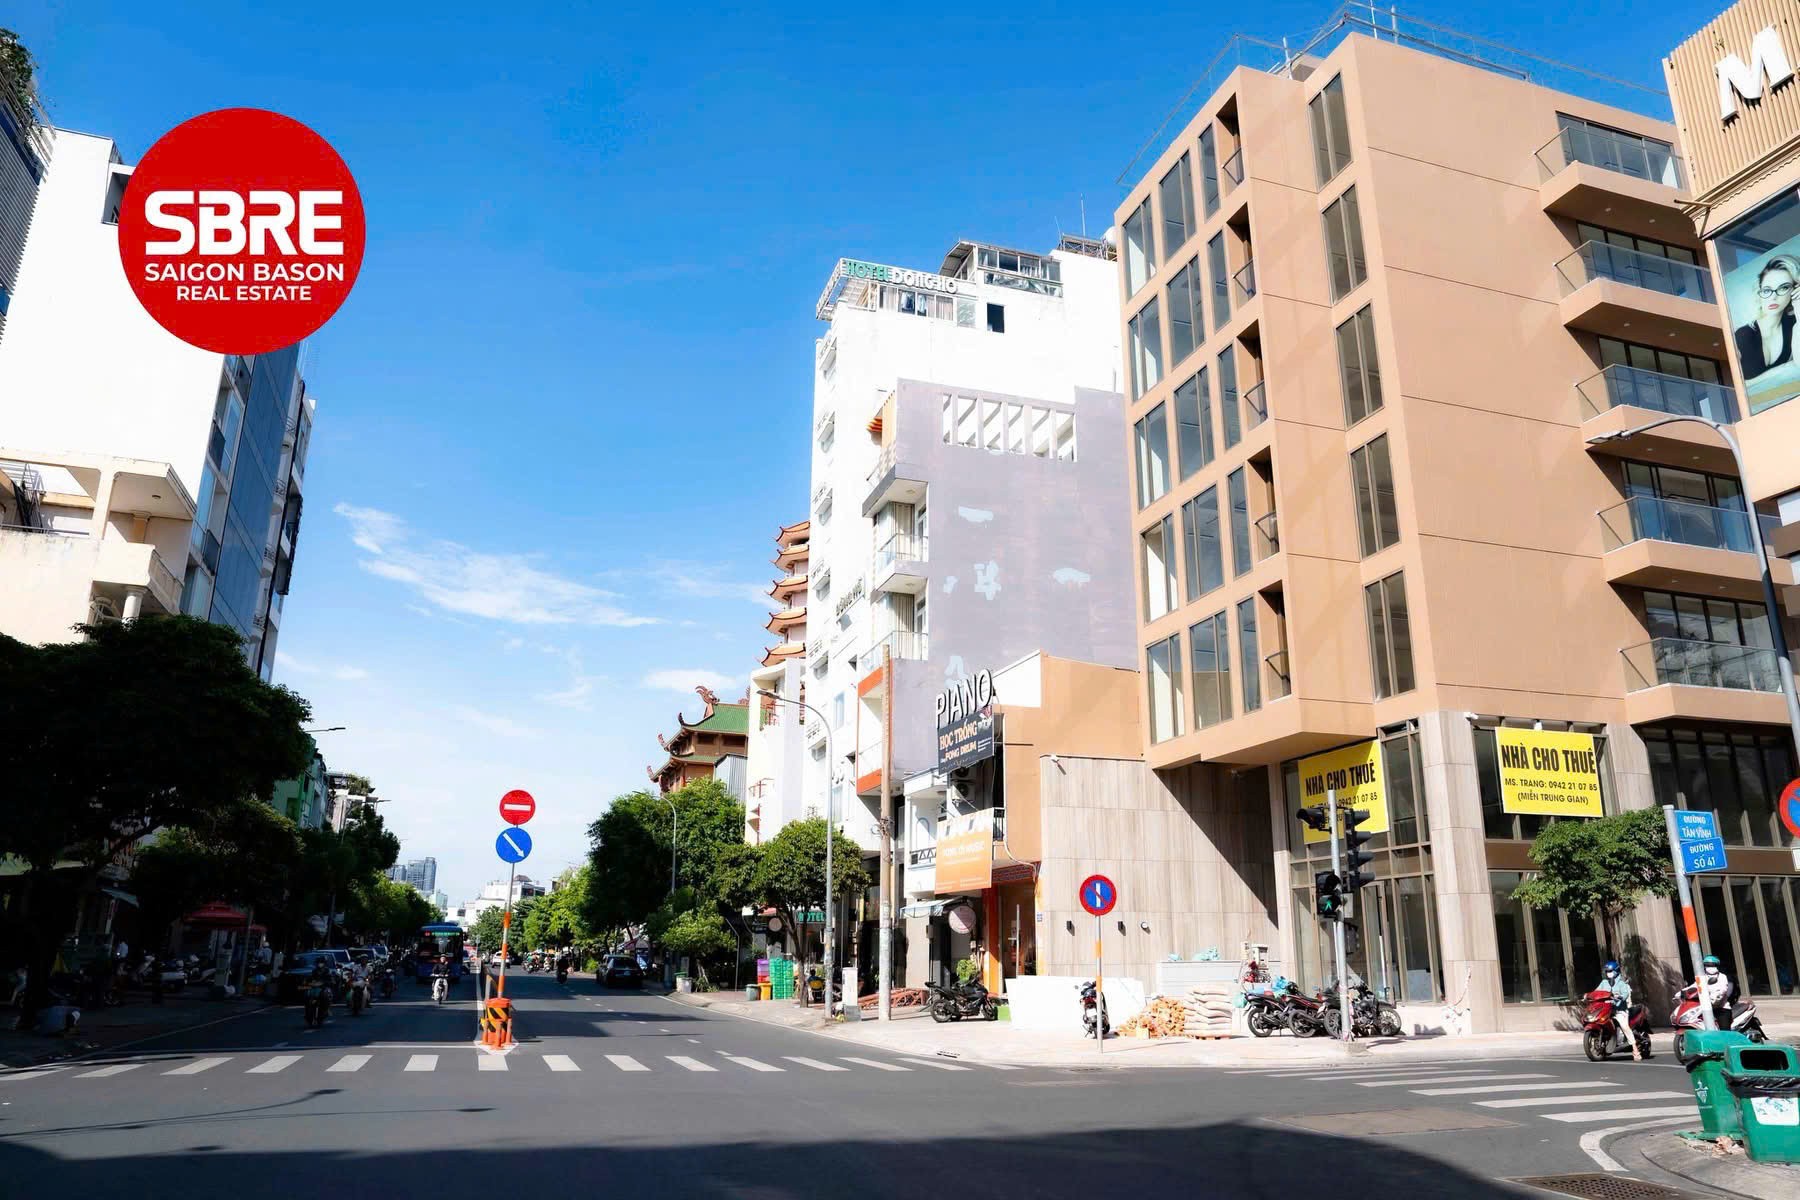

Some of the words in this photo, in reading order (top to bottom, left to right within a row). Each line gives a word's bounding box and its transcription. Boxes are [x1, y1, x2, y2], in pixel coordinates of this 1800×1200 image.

[846, 261, 888, 281] HOTEL
[936, 669, 992, 729] PIANO
[1501, 742, 1529, 769] NHÀ
[1532, 747, 1559, 772] CHO
[1562, 747, 1596, 774] THUÊ
[1305, 772, 1324, 797] NHÀ
[1327, 769, 1347, 791] CHO
[1349, 759, 1375, 786] THUÊ
[1548, 781, 1566, 790] 0942
[1568, 782, 1576, 790] 21
[1578, 783, 1586, 791] 07
[1541, 793, 1565, 803] TRUNG
[1694, 854, 1706, 868] SỐ
[1707, 857, 1715, 866] 41
